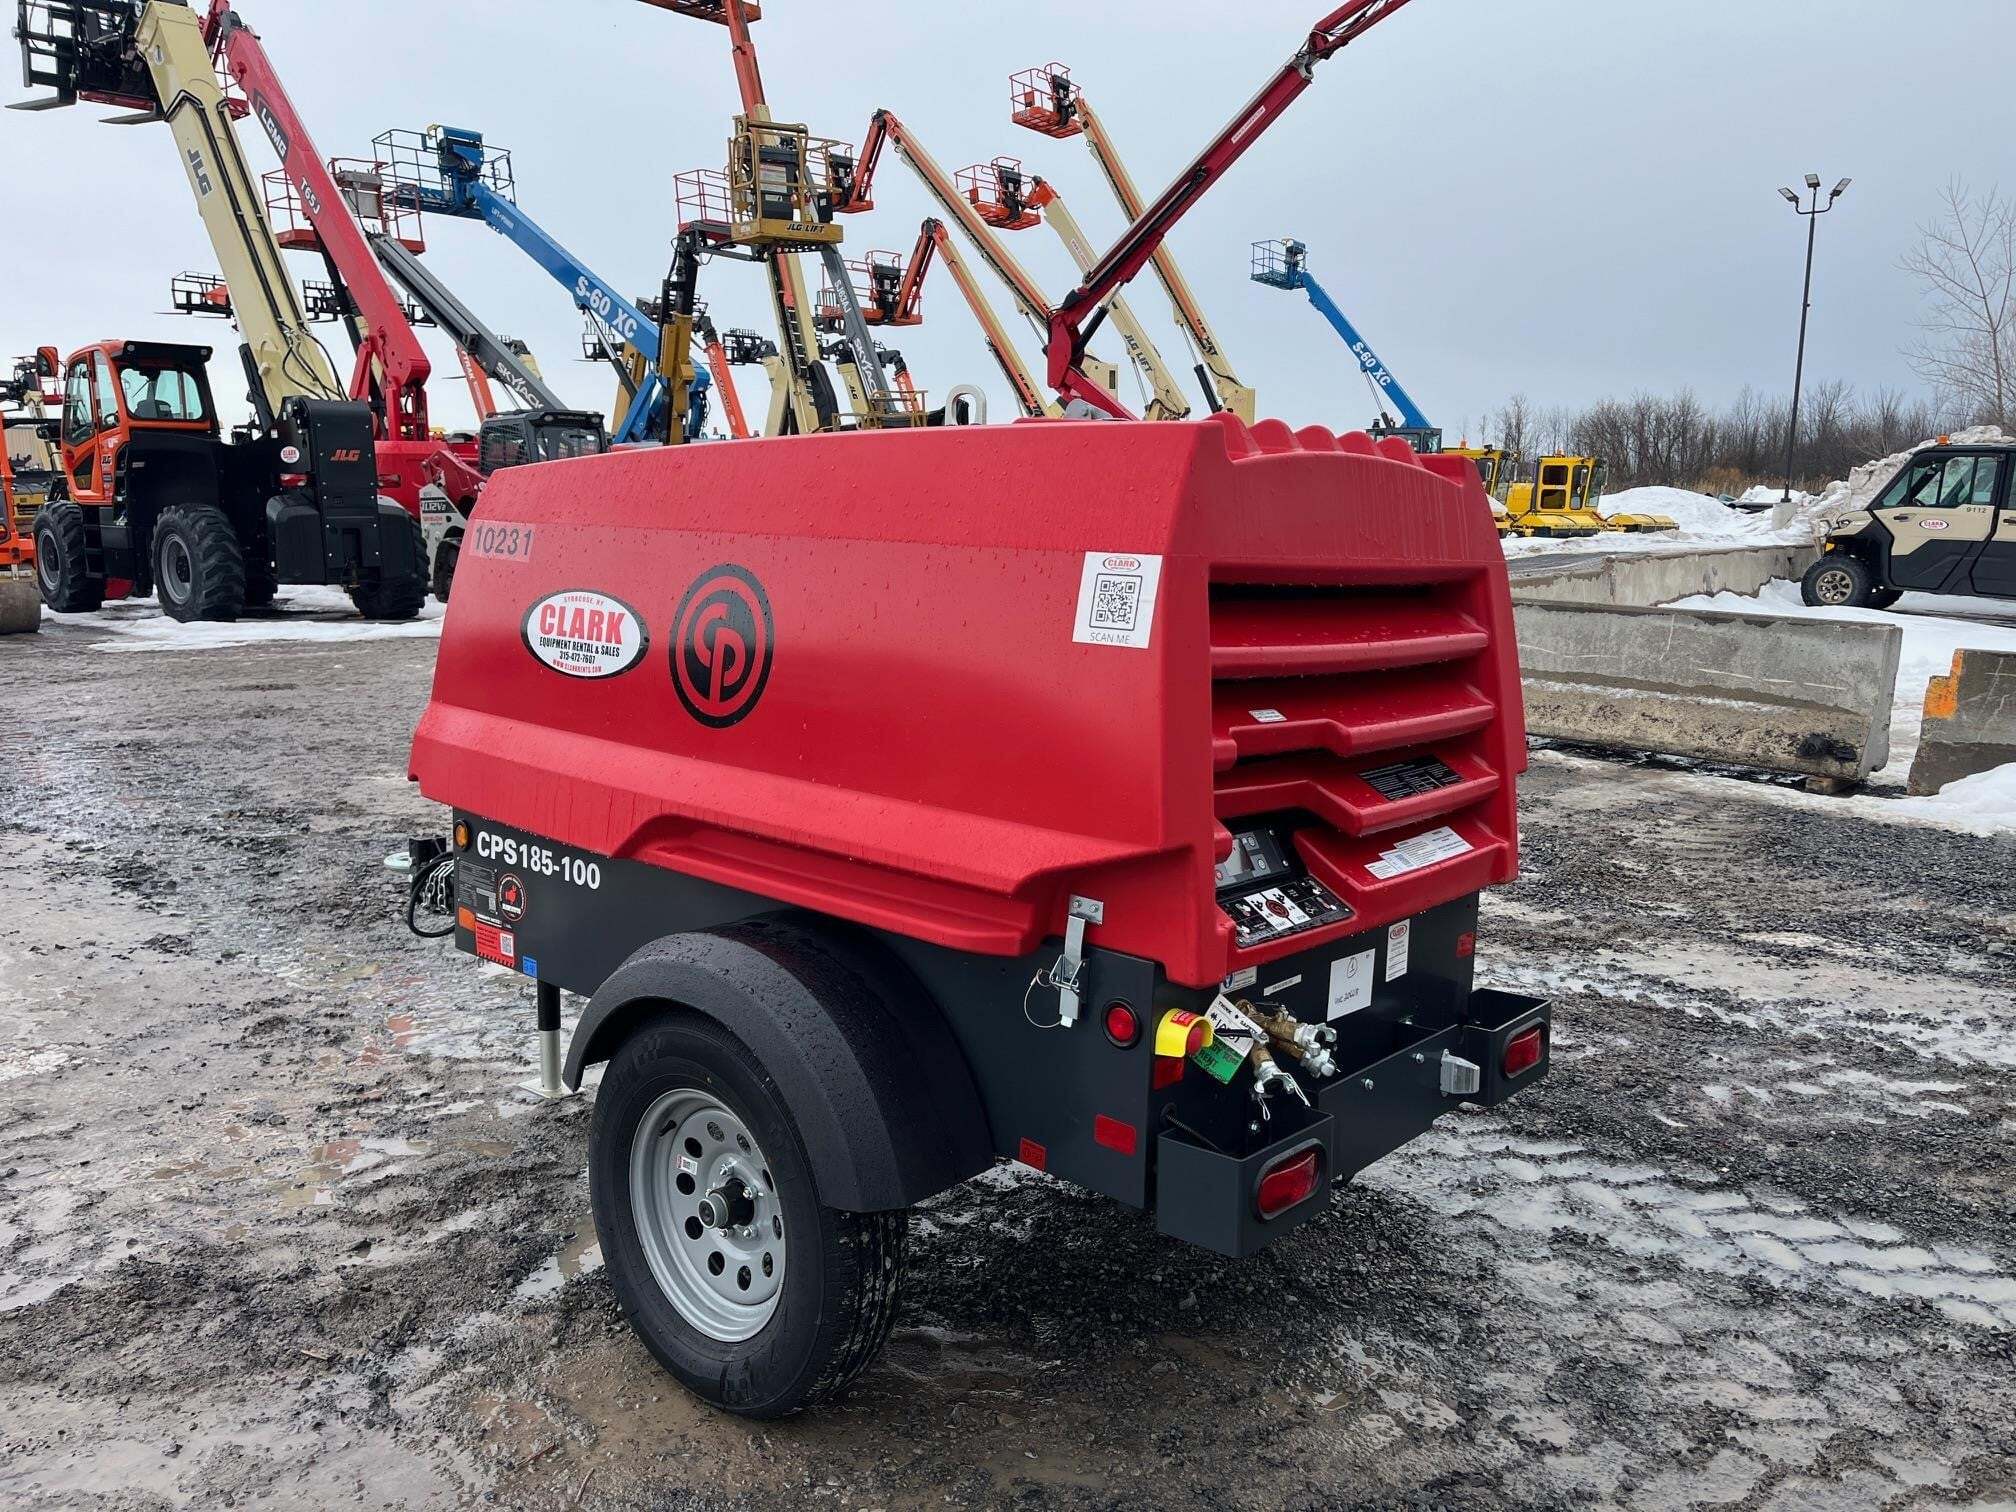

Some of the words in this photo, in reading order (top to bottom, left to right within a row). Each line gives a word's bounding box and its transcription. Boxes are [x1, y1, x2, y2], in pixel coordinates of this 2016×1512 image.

[261, 107, 287, 158] LGMG
[187, 148, 213, 196] JLG
[301, 177, 320, 215] T65J
[786, 223, 803, 231] JLG
[805, 224, 825, 233] LIFT
[575, 276, 611, 316] S-60
[612, 307, 638, 339] XC
[1124, 333, 1140, 352] JLG
[1135, 352, 1153, 373] LIFT
[1352, 341, 1377, 368] S-60
[1372, 367, 1391, 386] XC
[330, 449, 361, 461] JLG
[475, 525, 532, 556] 10231
[1107, 559, 1135, 568] CLARK
[539, 603, 626, 645] CLARK
[1089, 632, 1114, 643] SCAN
[1116, 633, 1131, 645] ME
[539, 636, 571, 652] EQUIPMENT
[572, 640, 594, 654] RENTAL
[594, 645, 600, 655] &
[600, 644, 620, 658] SALES
[476, 830, 601, 890] CPS185-100
